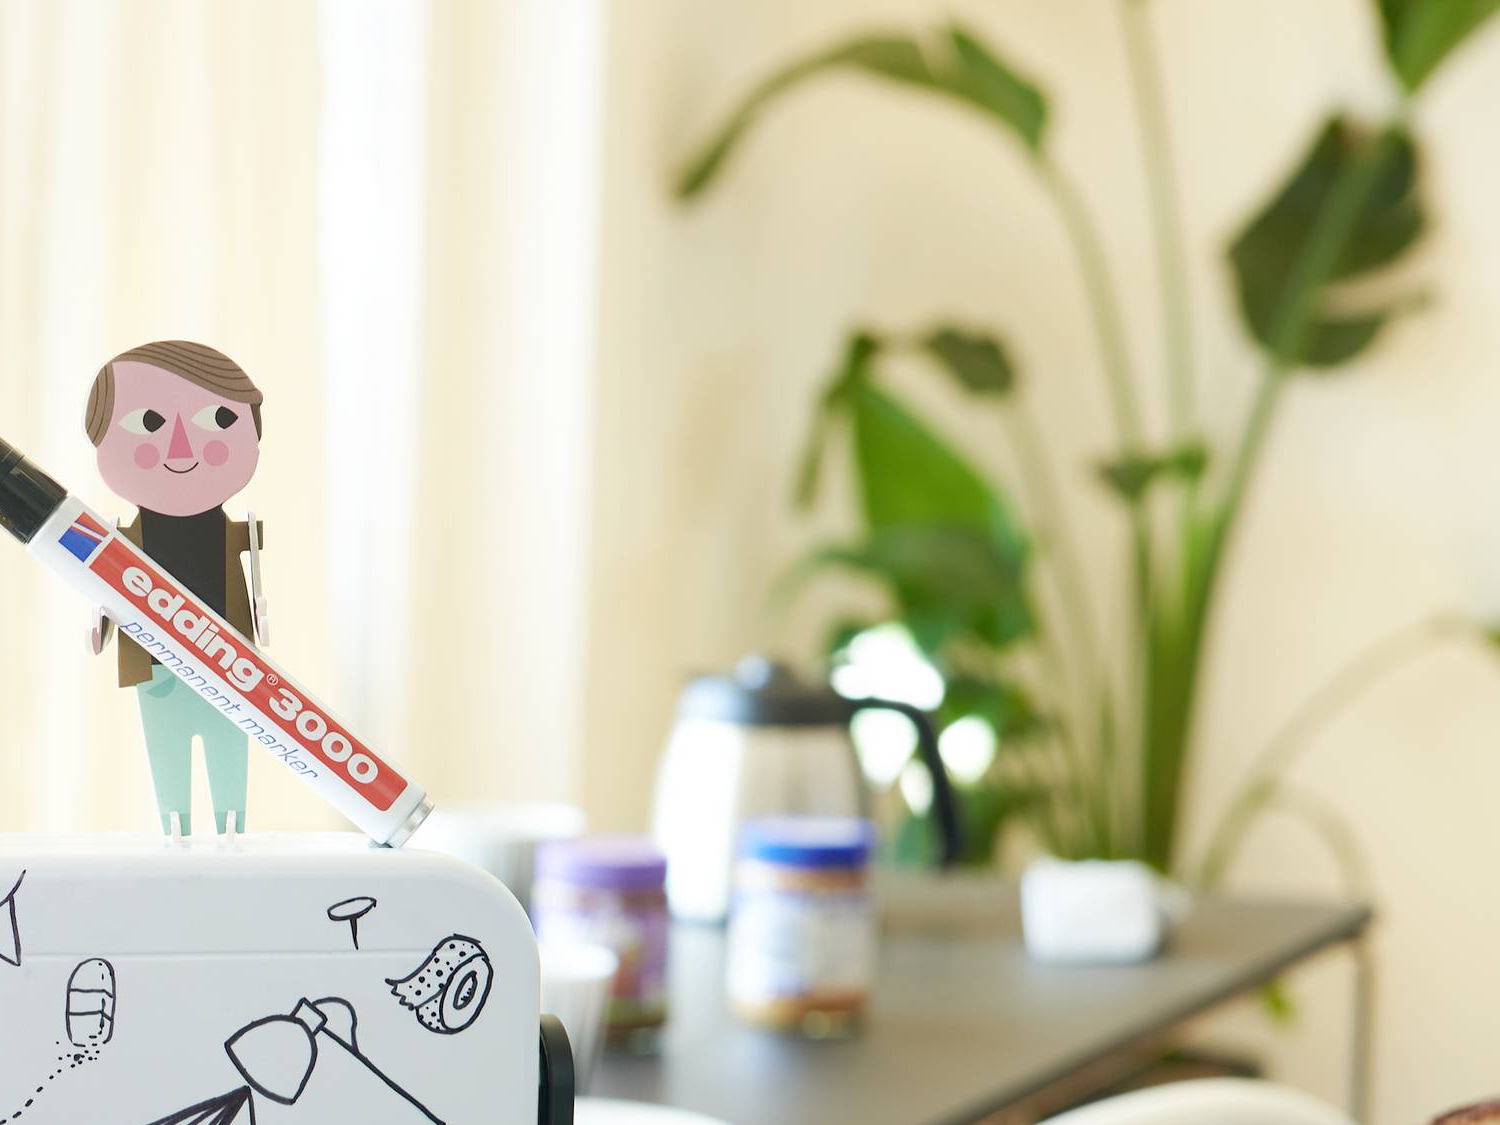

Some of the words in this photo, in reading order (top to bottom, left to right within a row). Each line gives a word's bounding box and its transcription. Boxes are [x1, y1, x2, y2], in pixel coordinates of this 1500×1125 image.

[120, 621, 242, 715] permanent
[238, 716, 319, 780] marker
[267, 687, 379, 784] 3000
